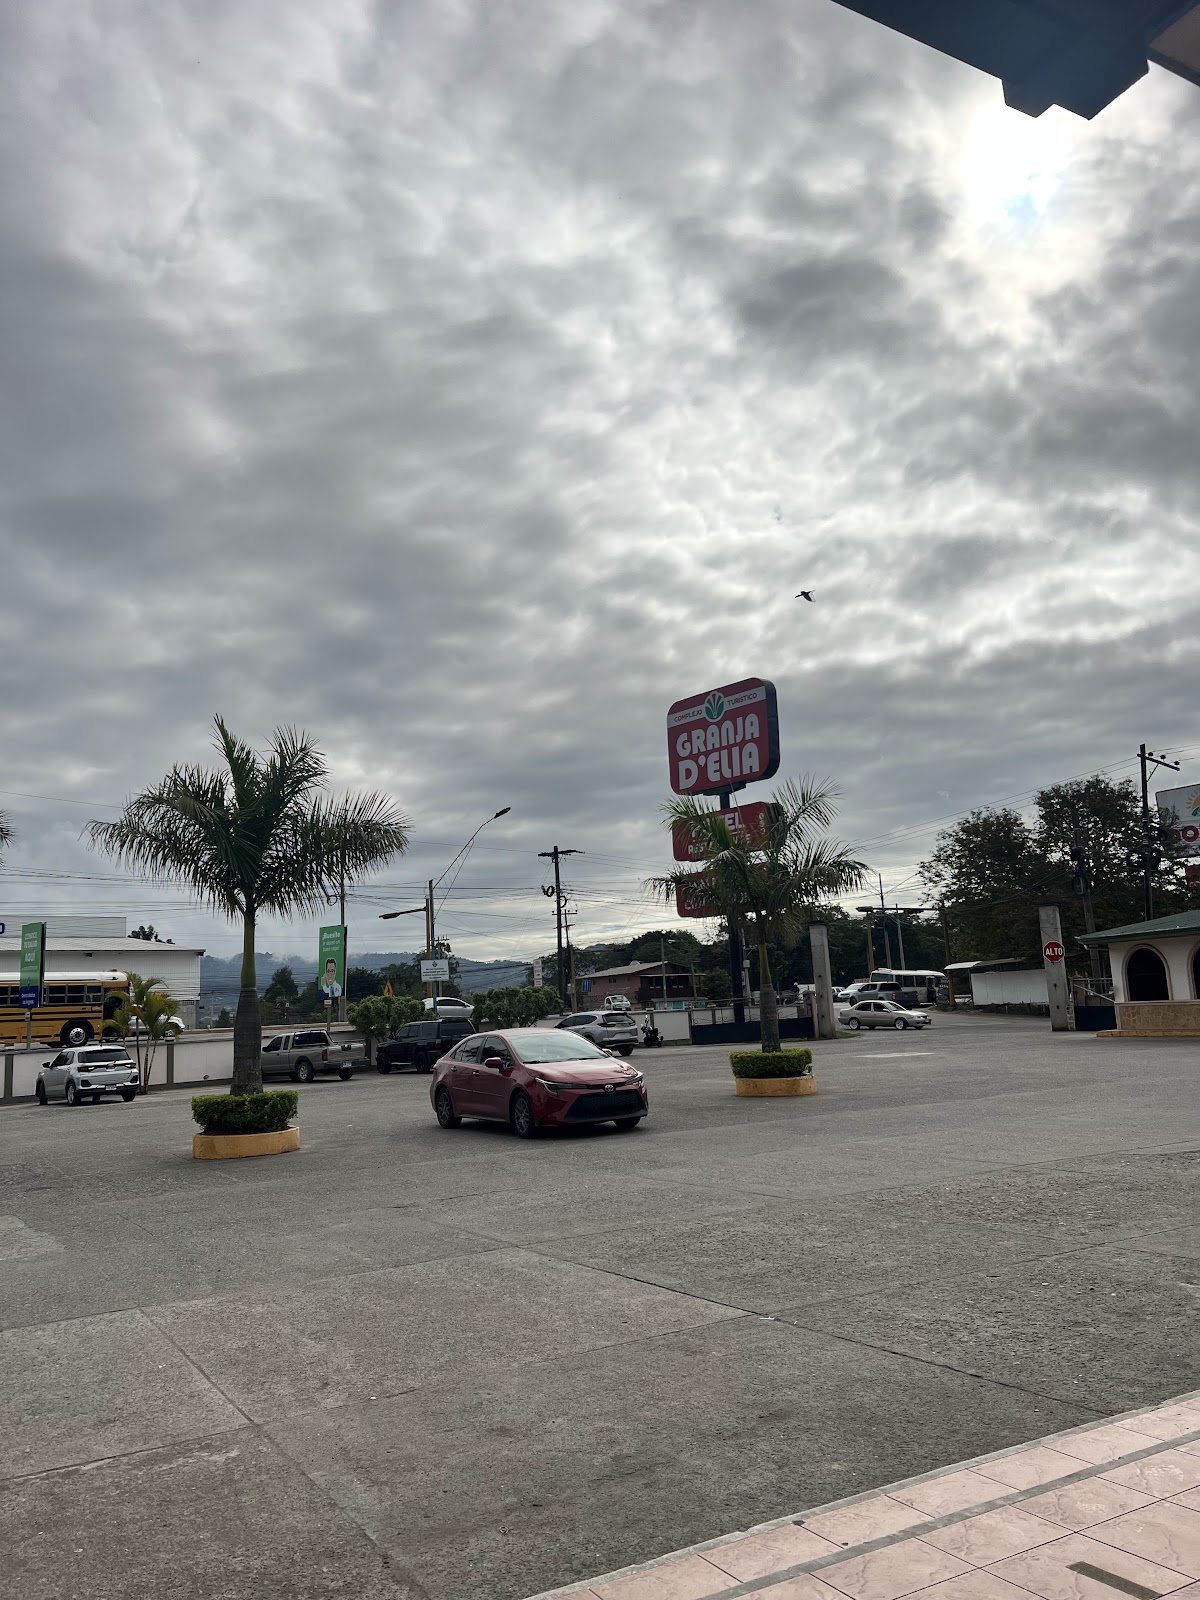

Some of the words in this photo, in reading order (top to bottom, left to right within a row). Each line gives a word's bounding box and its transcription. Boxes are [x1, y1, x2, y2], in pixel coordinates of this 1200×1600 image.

[674, 709, 702, 722] COMPLEJO
[727, 692, 758, 706] TURÍSTICO
[676, 713, 760, 758] GRANJA
[678, 742, 760, 790] D'ELIA
[1045, 947, 1063, 956] ALTO
